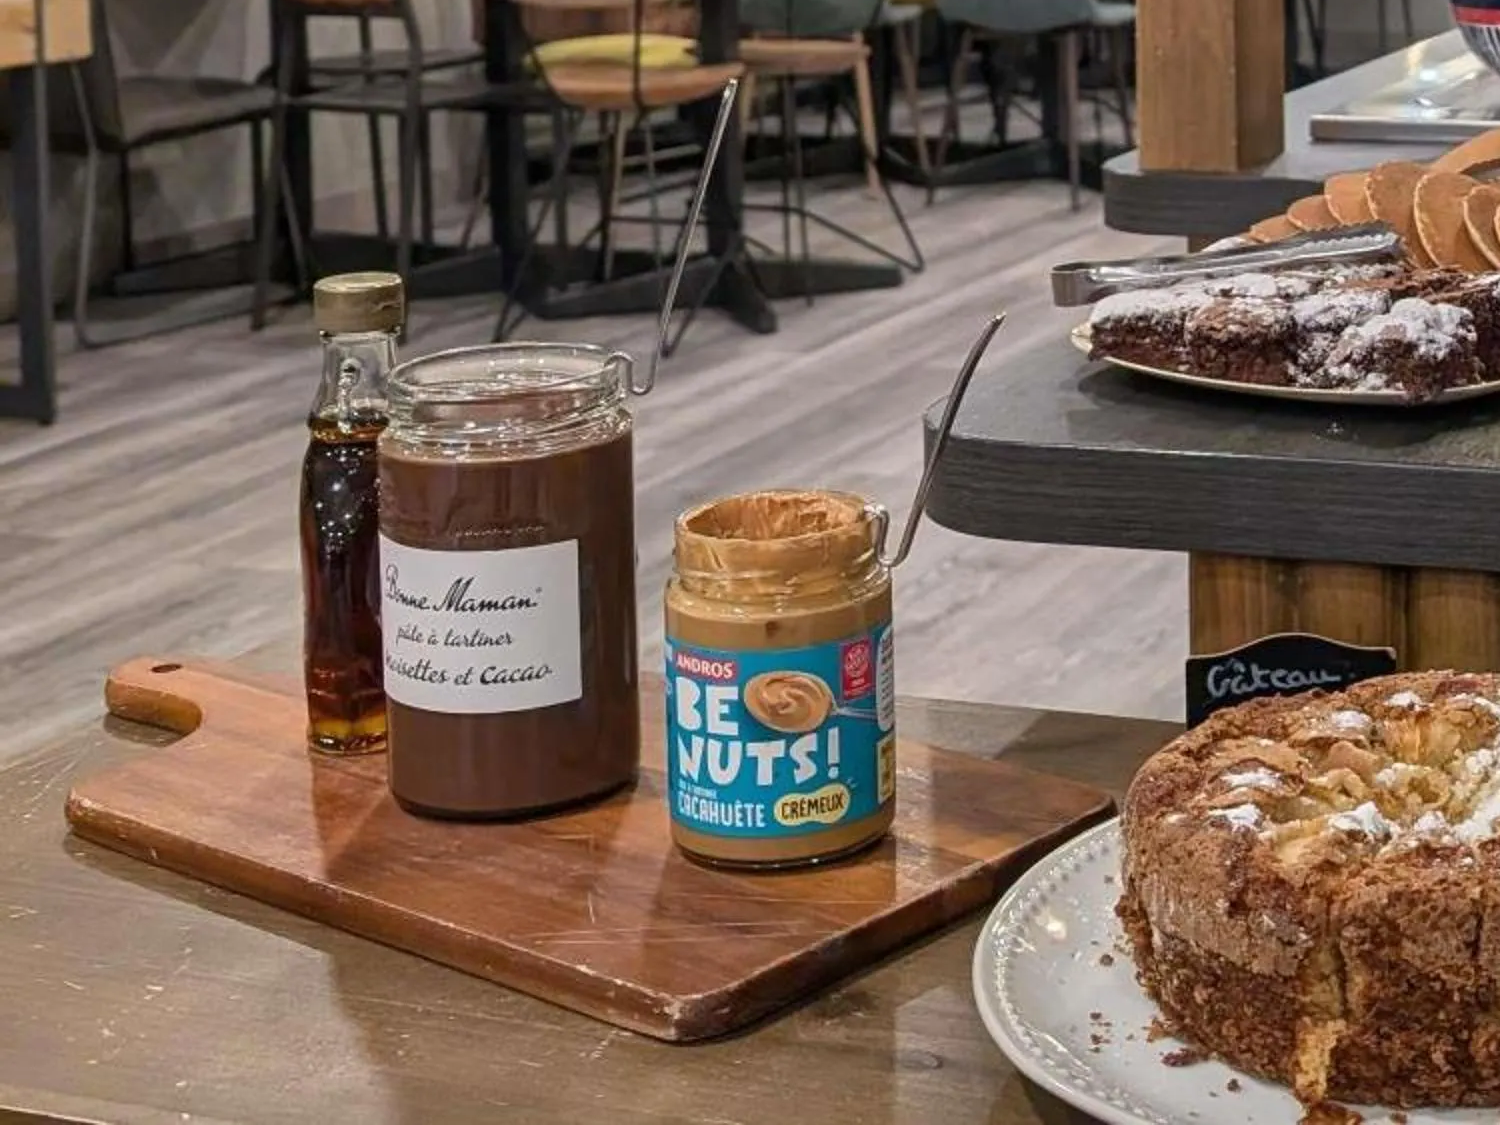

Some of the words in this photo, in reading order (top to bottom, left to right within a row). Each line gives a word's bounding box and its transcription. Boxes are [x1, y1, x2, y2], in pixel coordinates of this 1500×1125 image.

[385, 563, 430, 611] Bonne
[433, 576, 538, 613] Maman
[443, 627, 513, 647] tartiner
[454, 664, 473, 686] et
[479, 664, 552, 685] Cacao
[676, 654, 733, 679] ANDROS
[1207, 658, 1341, 697] Gâteau
[675, 676, 739, 736] BE
[677, 725, 840, 786] NUTS!
